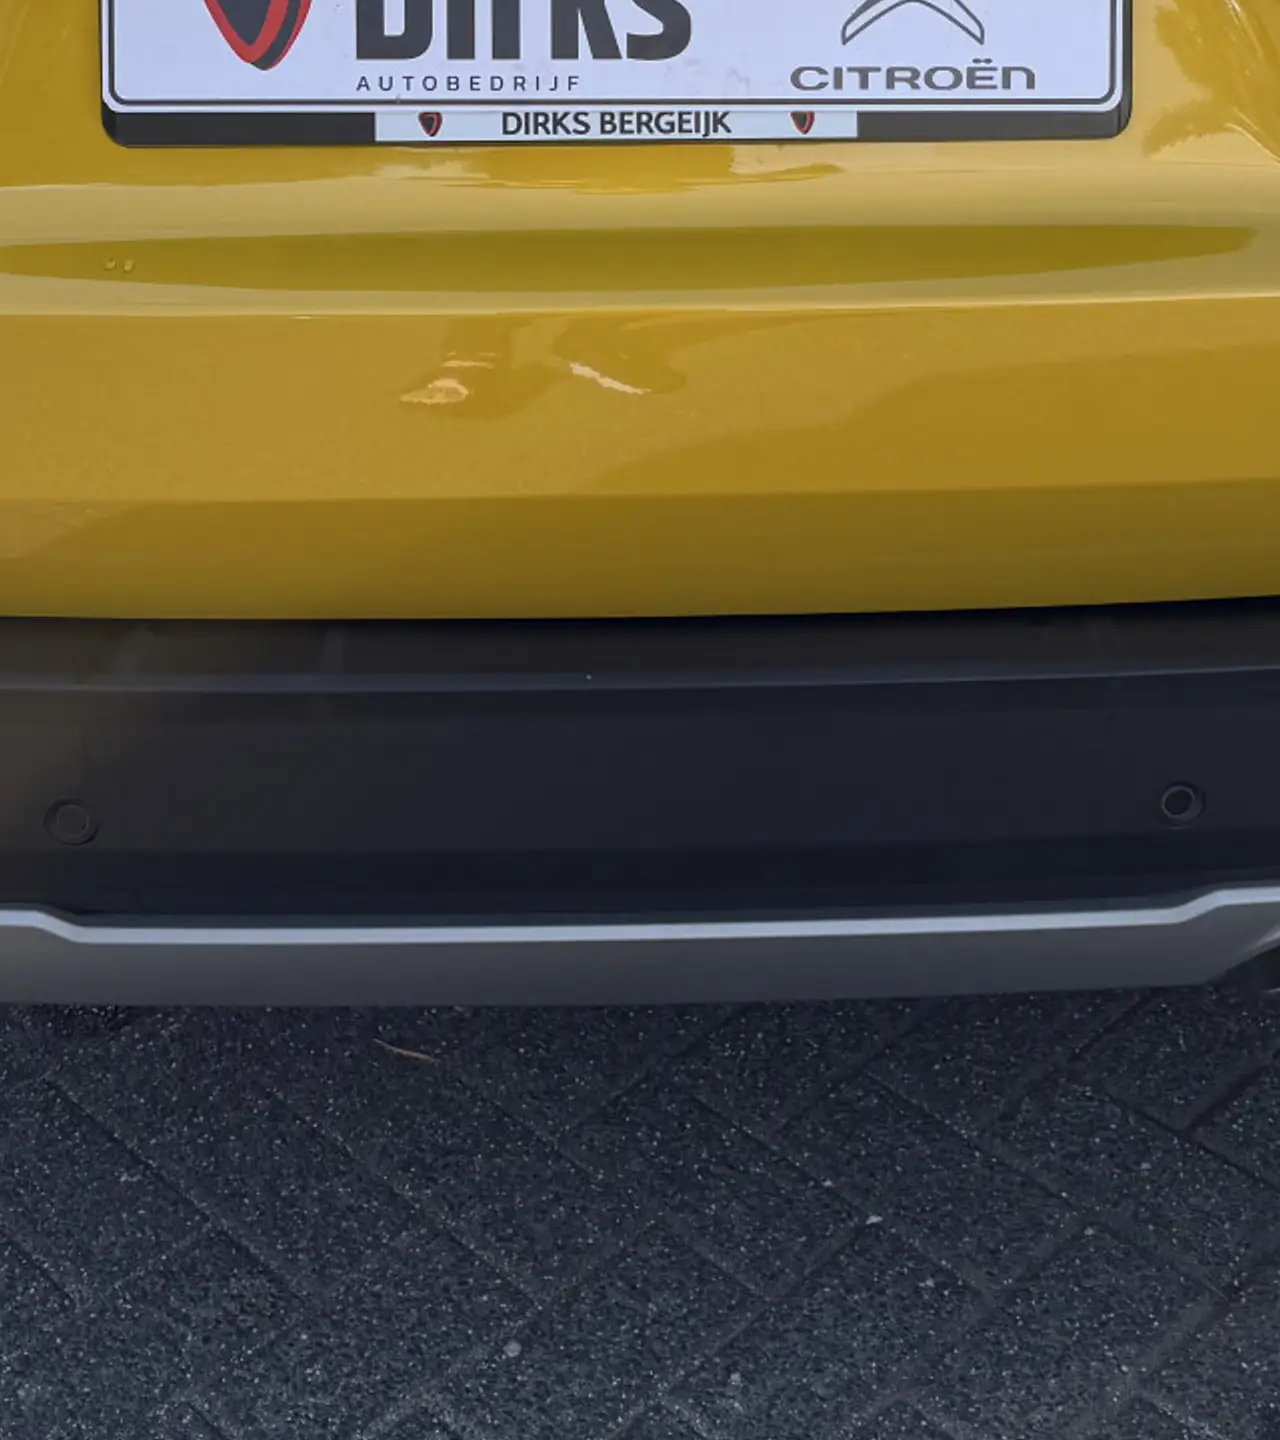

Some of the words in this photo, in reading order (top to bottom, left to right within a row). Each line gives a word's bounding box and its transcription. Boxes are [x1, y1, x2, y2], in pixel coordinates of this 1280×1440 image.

[356, 75, 580, 92] AUTOBEDRIJF
[501, 111, 591, 136] DIRKS
[599, 111, 733, 137] BERGEIJK
